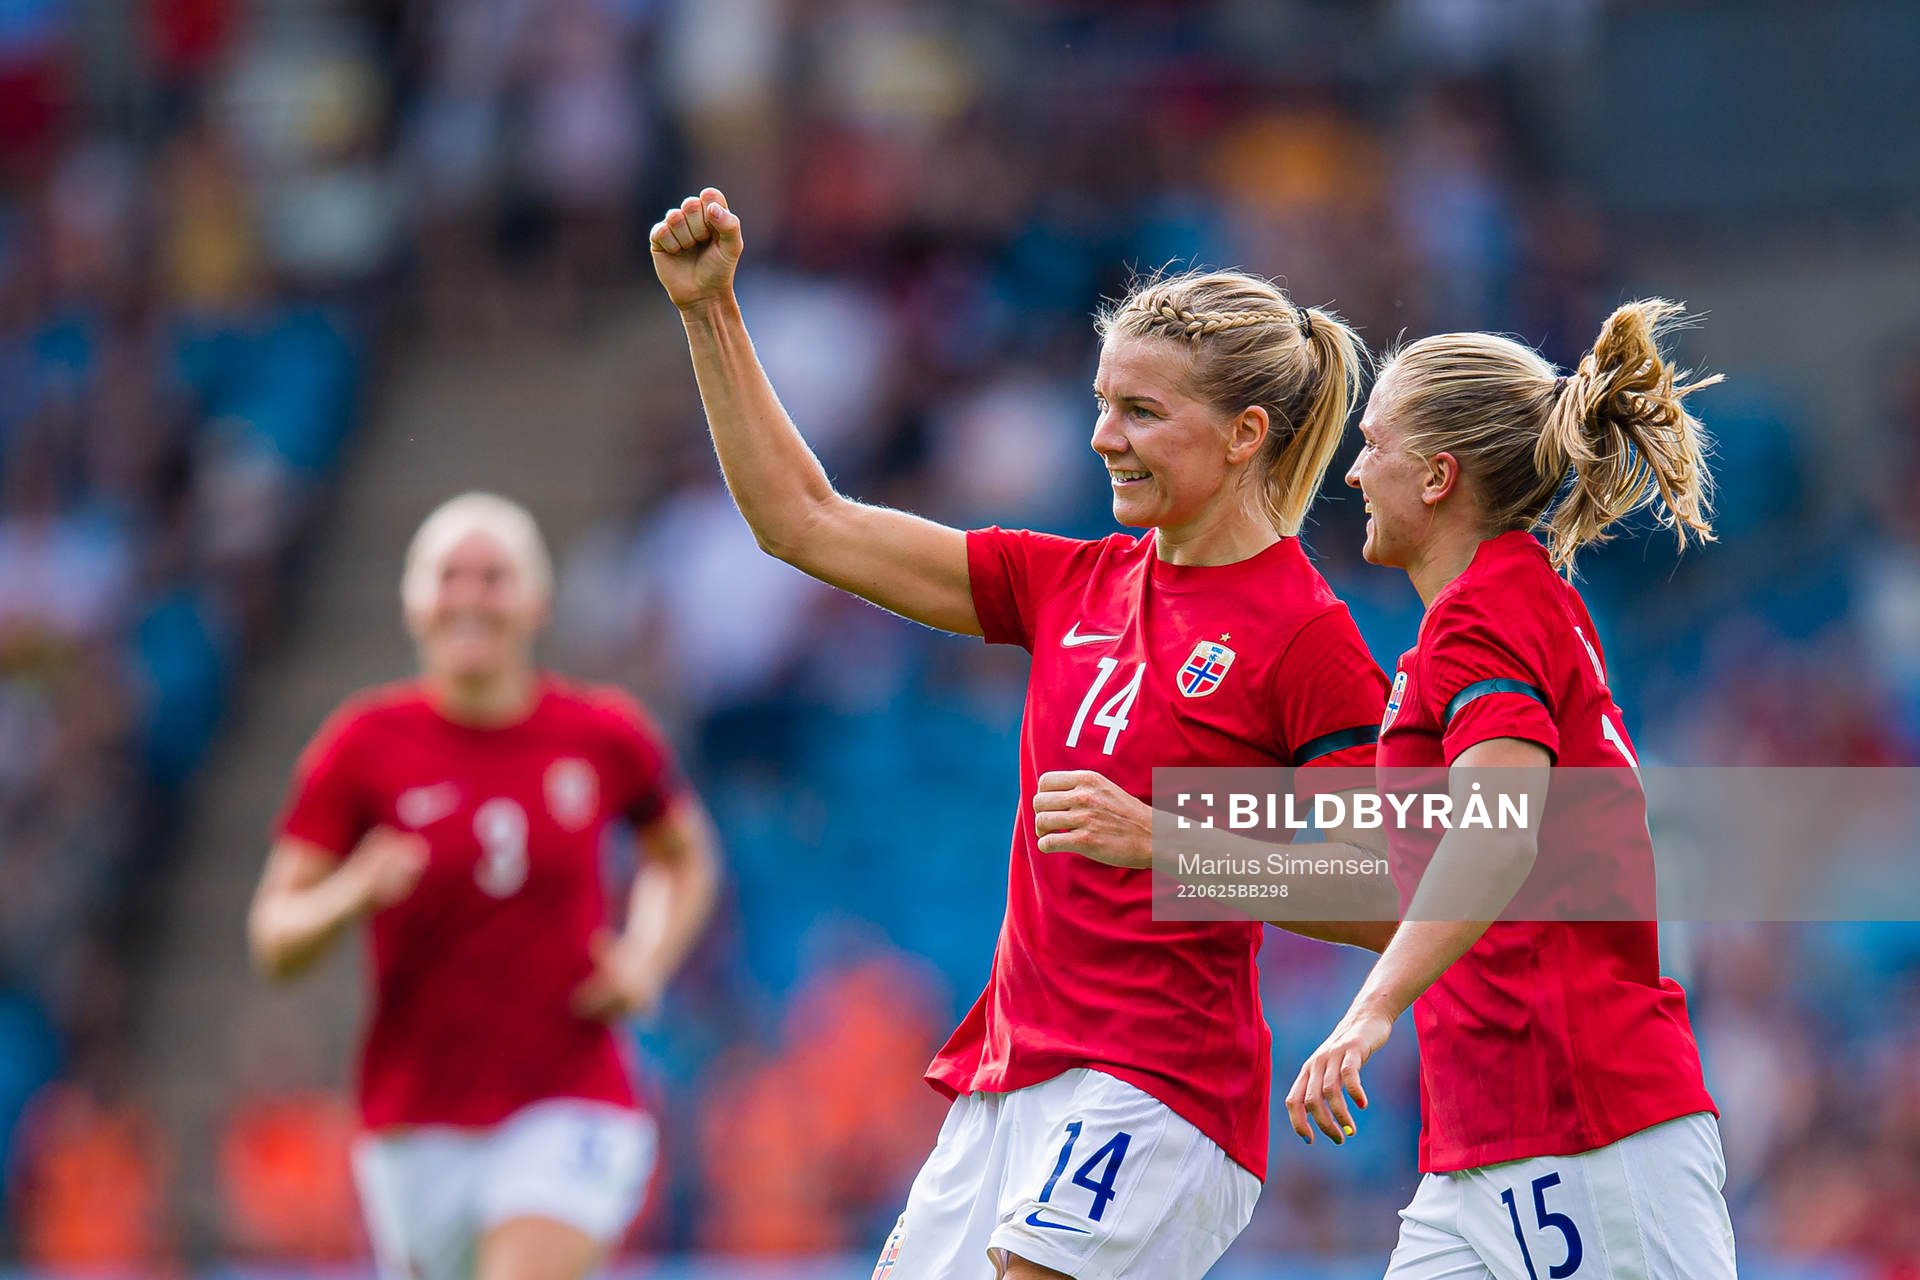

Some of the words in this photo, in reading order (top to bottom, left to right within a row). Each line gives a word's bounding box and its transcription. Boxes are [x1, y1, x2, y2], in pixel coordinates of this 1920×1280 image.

[1065, 656, 1147, 756] 14
[1038, 1120, 1132, 1222] 14
[1500, 1171, 1583, 1280] 15
